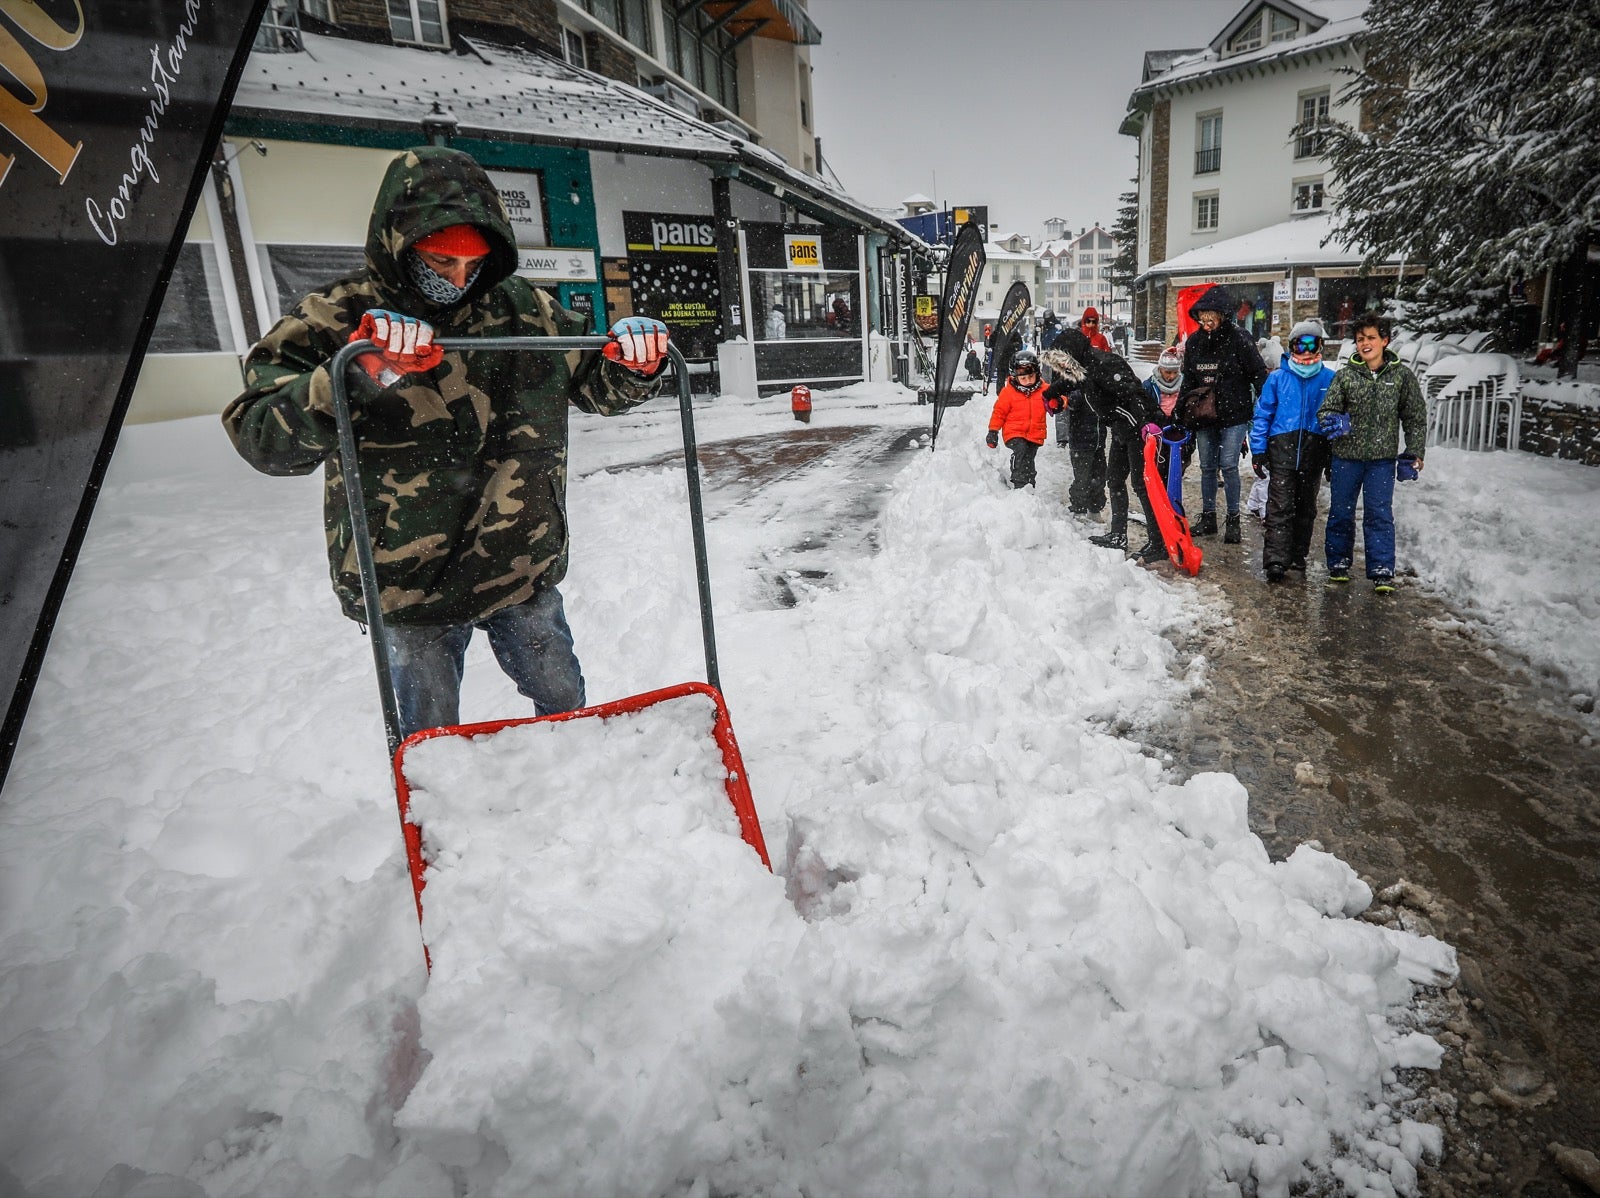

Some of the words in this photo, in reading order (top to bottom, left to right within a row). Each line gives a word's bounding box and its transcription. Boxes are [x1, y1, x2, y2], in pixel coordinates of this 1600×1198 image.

[652, 219, 713, 251] pans
[789, 245, 817, 261] pans
[525, 258, 557, 268] AWAY
[948, 251, 979, 334] Imperiale
[684, 302, 706, 310] GUSTAN
